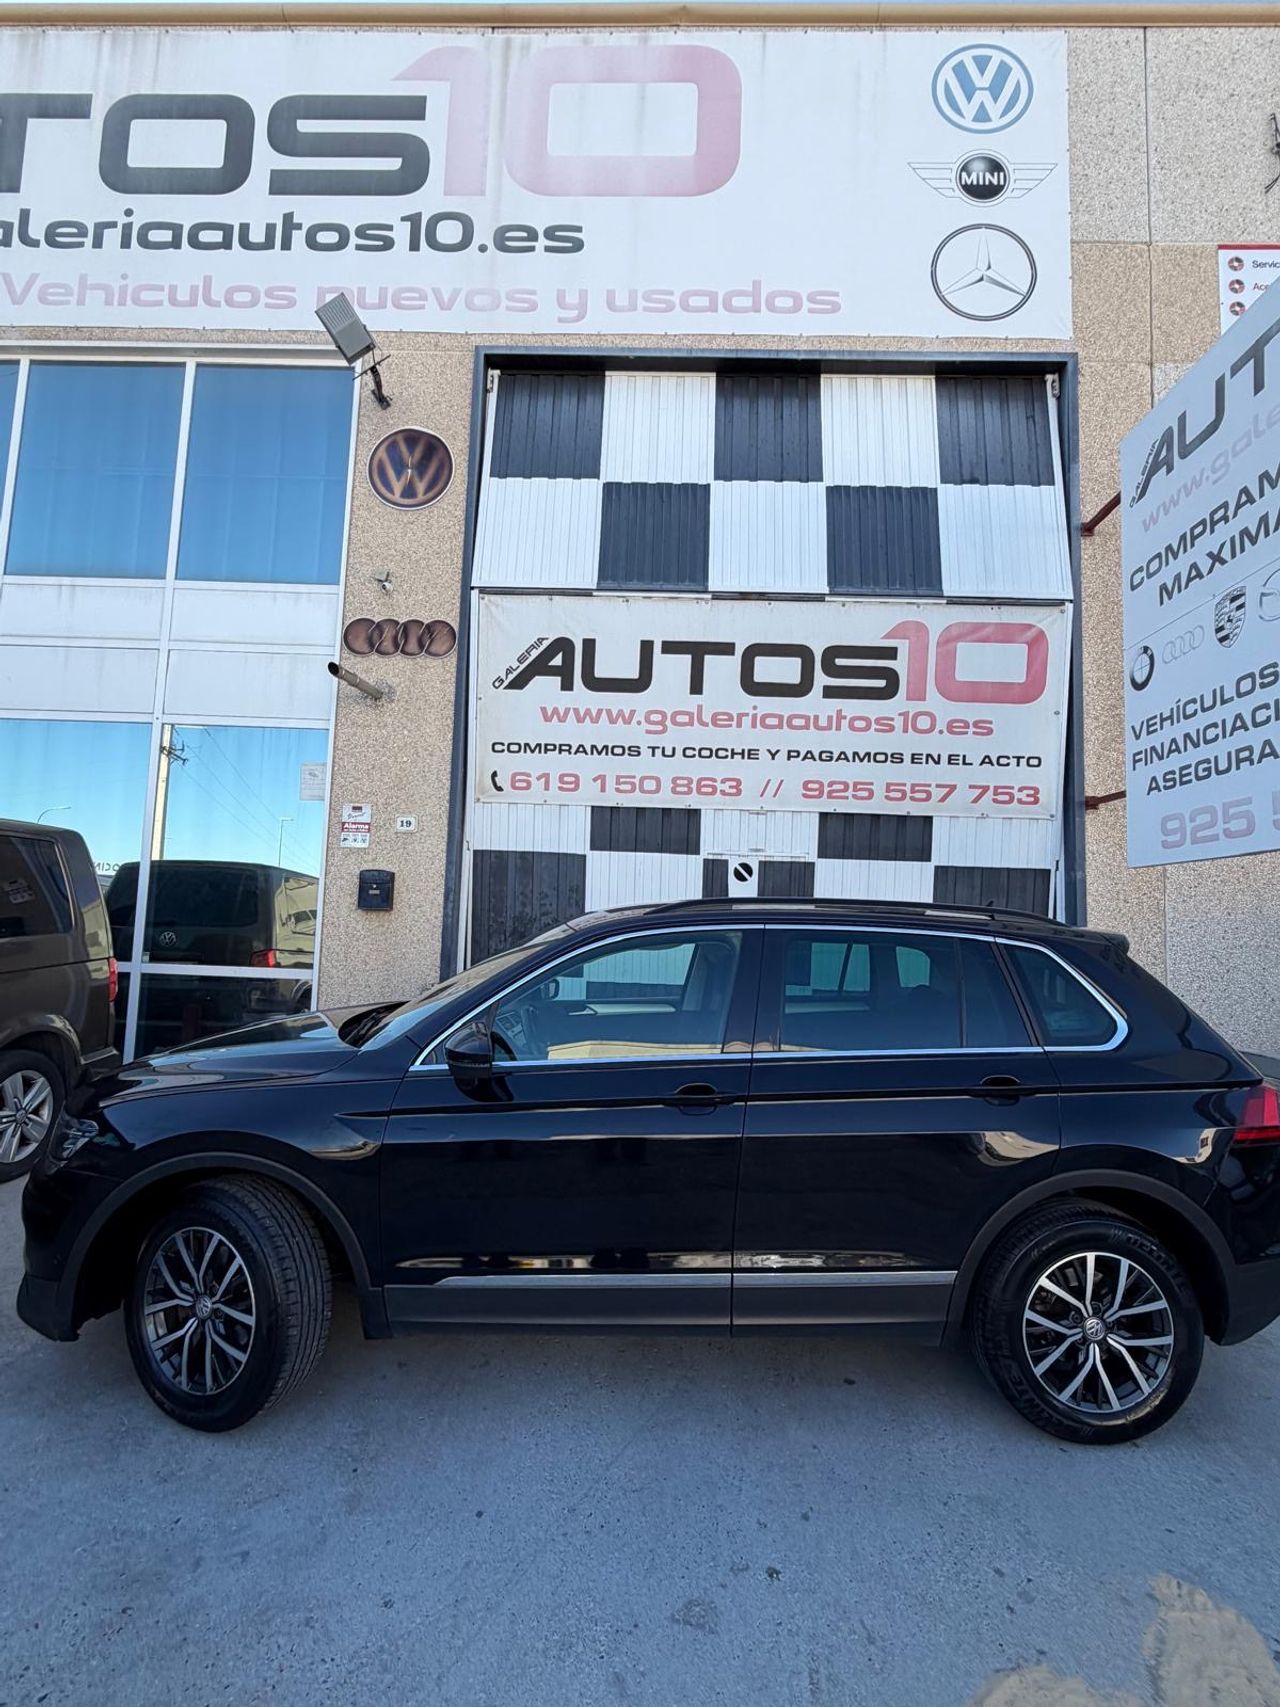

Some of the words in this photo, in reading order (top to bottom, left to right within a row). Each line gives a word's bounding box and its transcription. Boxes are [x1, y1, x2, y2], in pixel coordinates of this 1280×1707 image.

[961, 171, 1005, 186] MINI
[0, 208, 584, 253] leriaautos10.es
[1, 272, 297, 309] Vehiculos
[556, 288, 588, 323] y
[606, 279, 842, 314] usados
[491, 636, 550, 690] GALERIA
[503, 620, 1049, 704] AUTOS10
[540, 704, 994, 737] www.galeriaautos10.es
[1131, 661, 1279, 741] VEHÍCULOS
[491, 741, 641, 757] COMPRAMOS
[647, 746, 676, 758] TU
[682, 747, 760, 760] COCHE
[767, 749, 780, 761] Y
[787, 749, 904, 764] PAGAMOS
[910, 753, 942, 765] EN
[947, 754, 973, 766] EL
[978, 755, 1043, 768] ACTO
[510, 772, 580, 793] 619
[592, 774, 661, 794] 150
[670, 776, 743, 797] 863
[801, 779, 874, 800] 925
[884, 782, 957, 803] 557
[968, 784, 1040, 806] 753
[1161, 797, 1256, 850] 925
